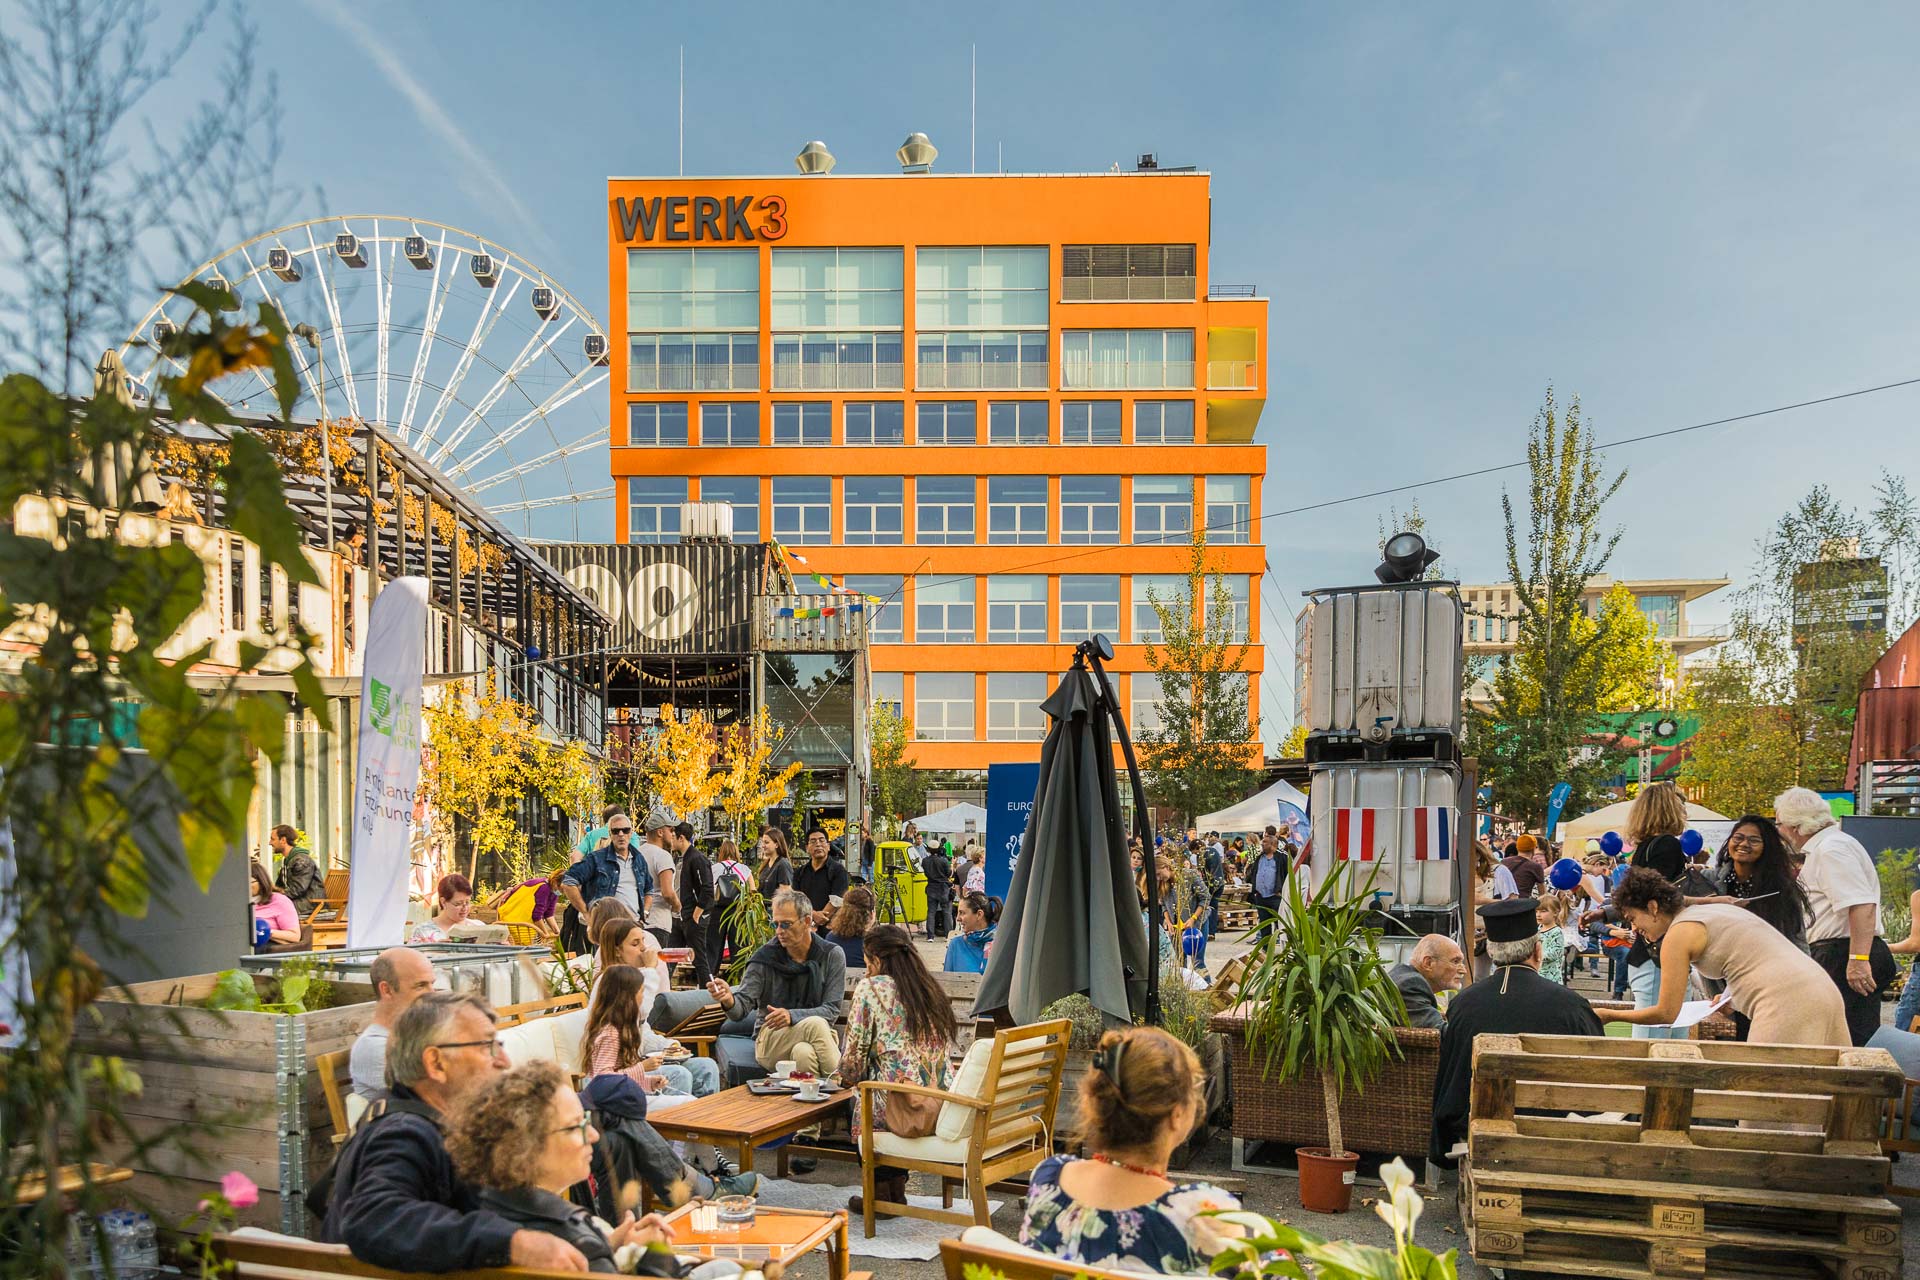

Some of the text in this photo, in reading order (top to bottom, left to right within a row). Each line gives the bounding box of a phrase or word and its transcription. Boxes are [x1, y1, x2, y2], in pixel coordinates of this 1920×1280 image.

[617, 195, 788, 241] WERK3
[1491, 1236, 1512, 1248] EPAL
[1864, 1230, 1888, 1242] EUR
